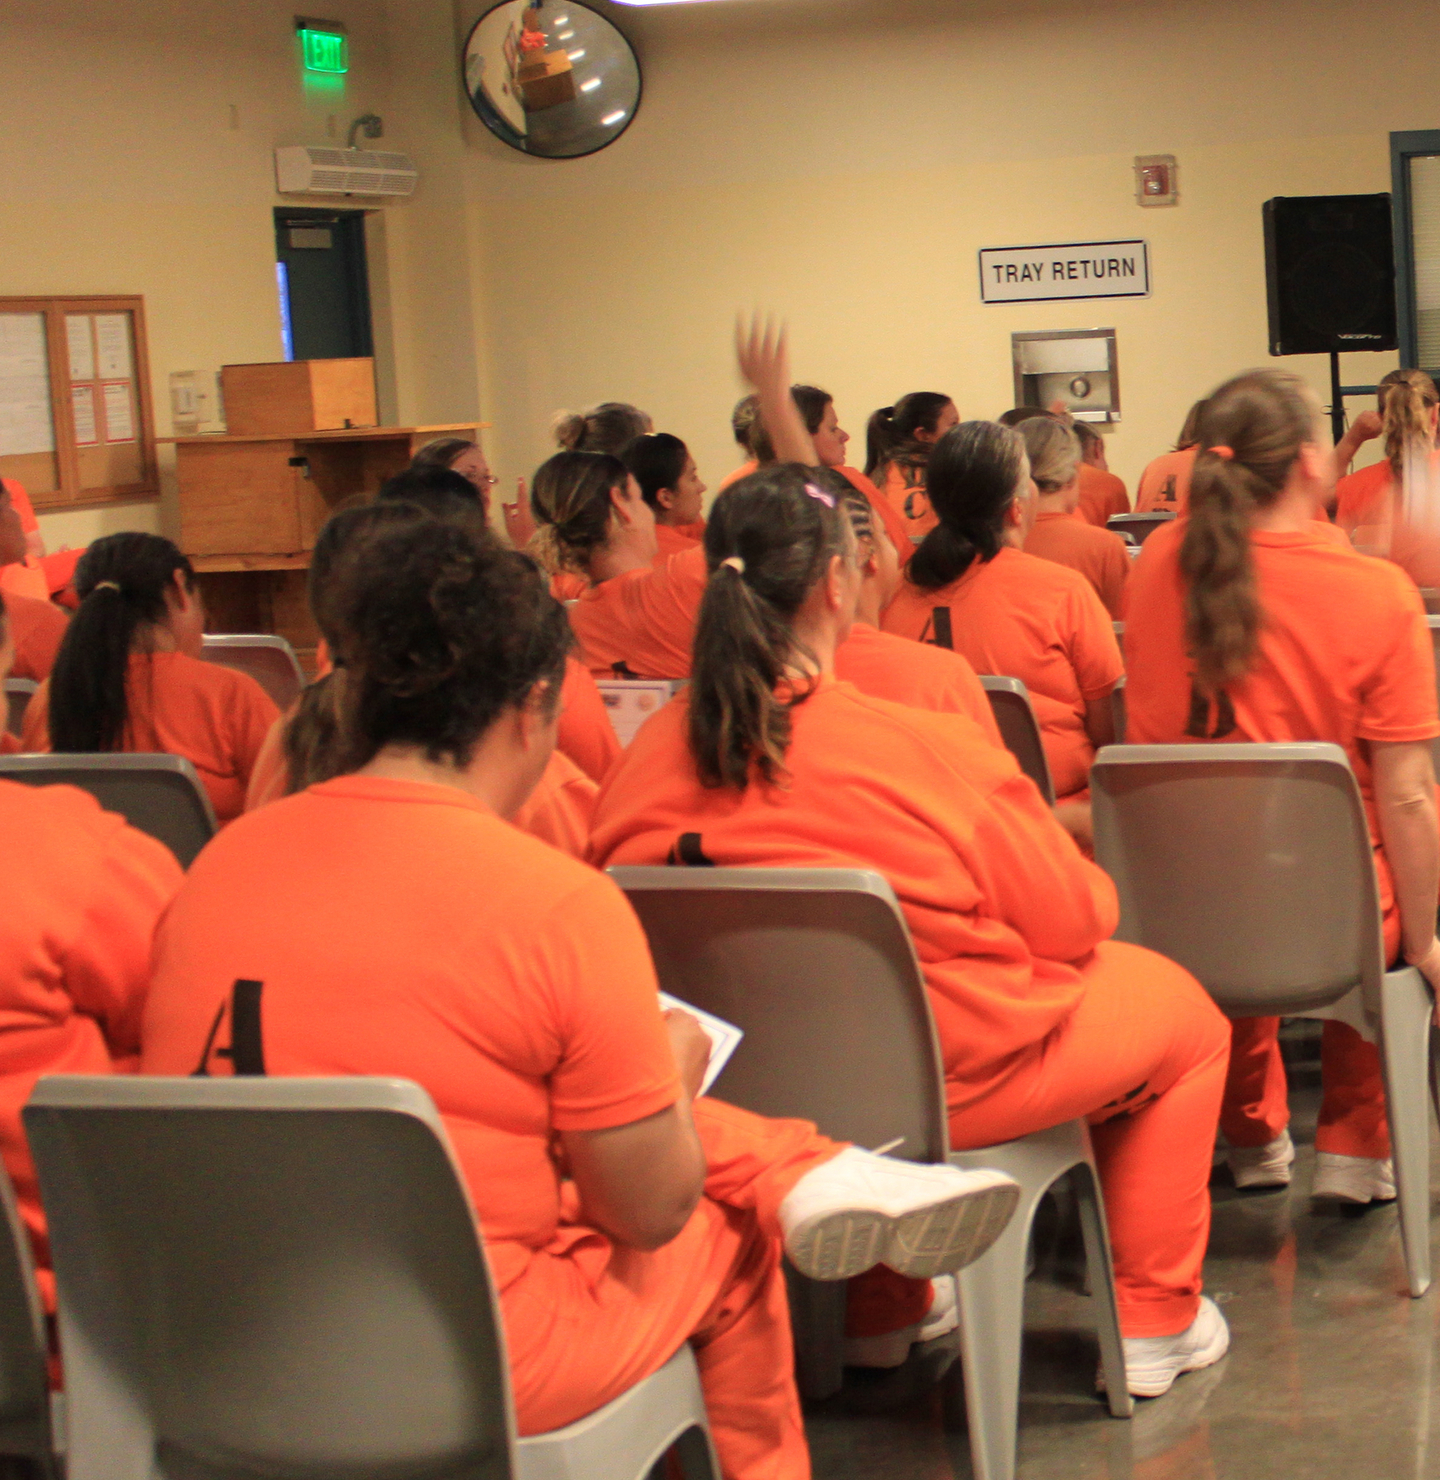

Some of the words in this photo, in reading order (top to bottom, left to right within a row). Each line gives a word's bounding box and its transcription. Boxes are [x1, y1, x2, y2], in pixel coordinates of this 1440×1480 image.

[311, 34, 342, 69] EXIT
[992, 262, 1044, 284] TRAY
[1052, 257, 1135, 281] RETURN
[189, 978, 267, 1077] A
